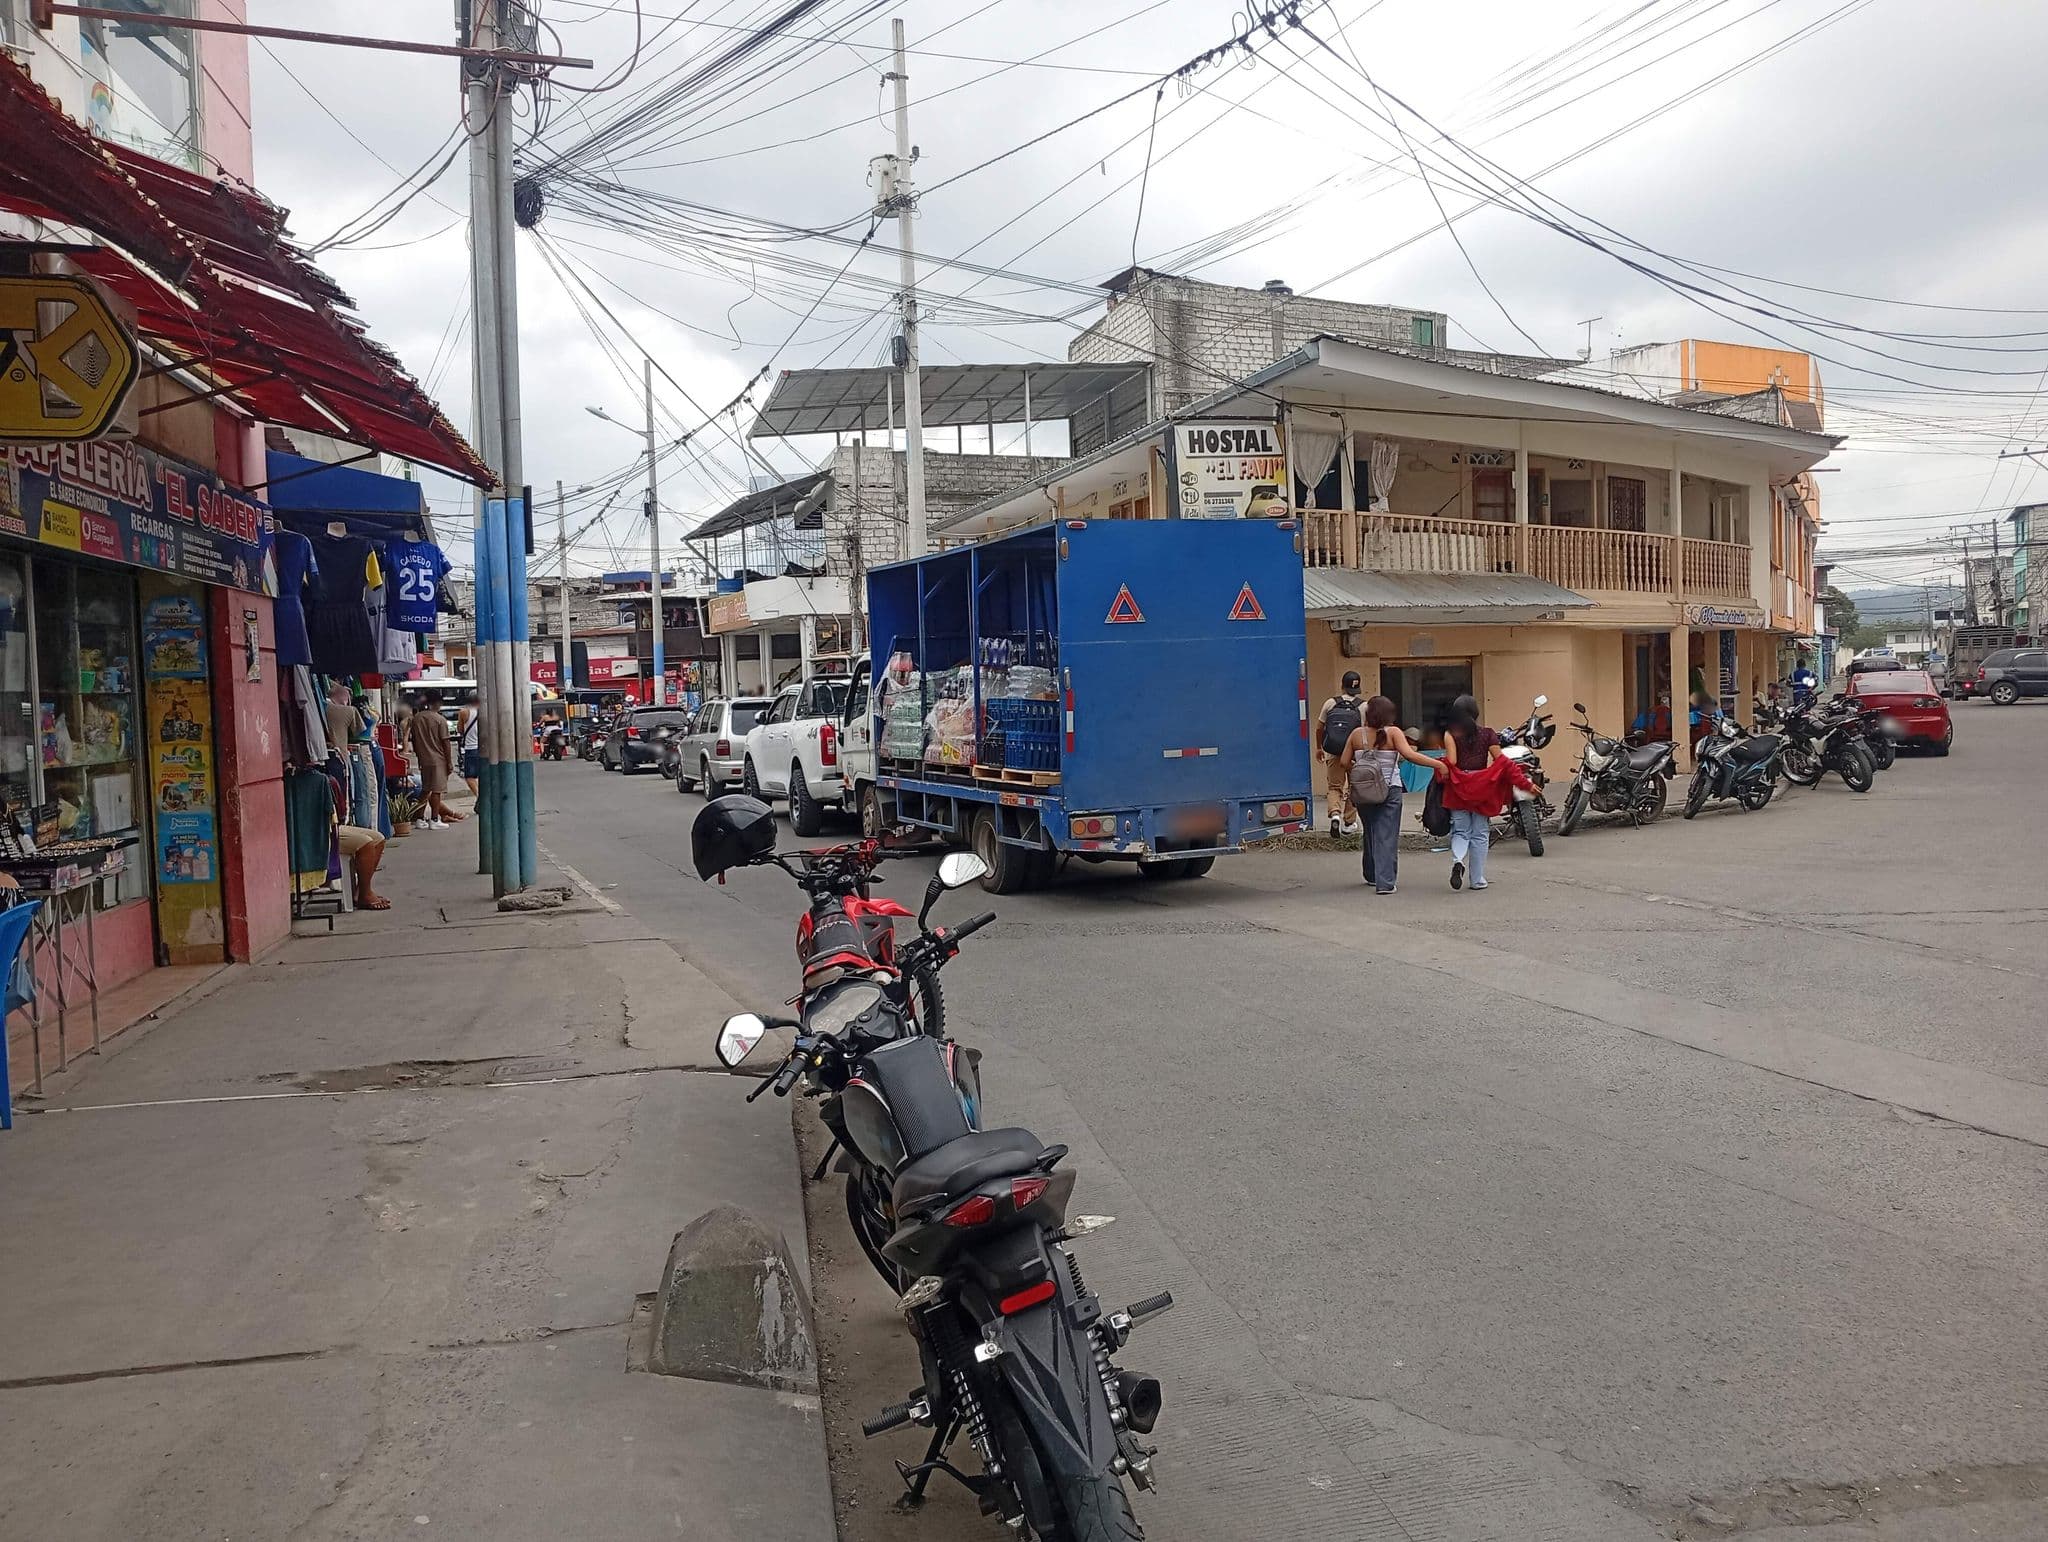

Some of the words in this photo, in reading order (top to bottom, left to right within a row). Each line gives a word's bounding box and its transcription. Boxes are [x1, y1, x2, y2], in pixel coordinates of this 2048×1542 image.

[1188, 429, 1273, 453] HOSTAL
[58, 484, 76, 506] SABER
[131, 512, 174, 541] RECARGAS
[399, 553, 432, 569] CAICEDO
[399, 567, 435, 602] 25
[400, 615, 434, 624] SKODA
